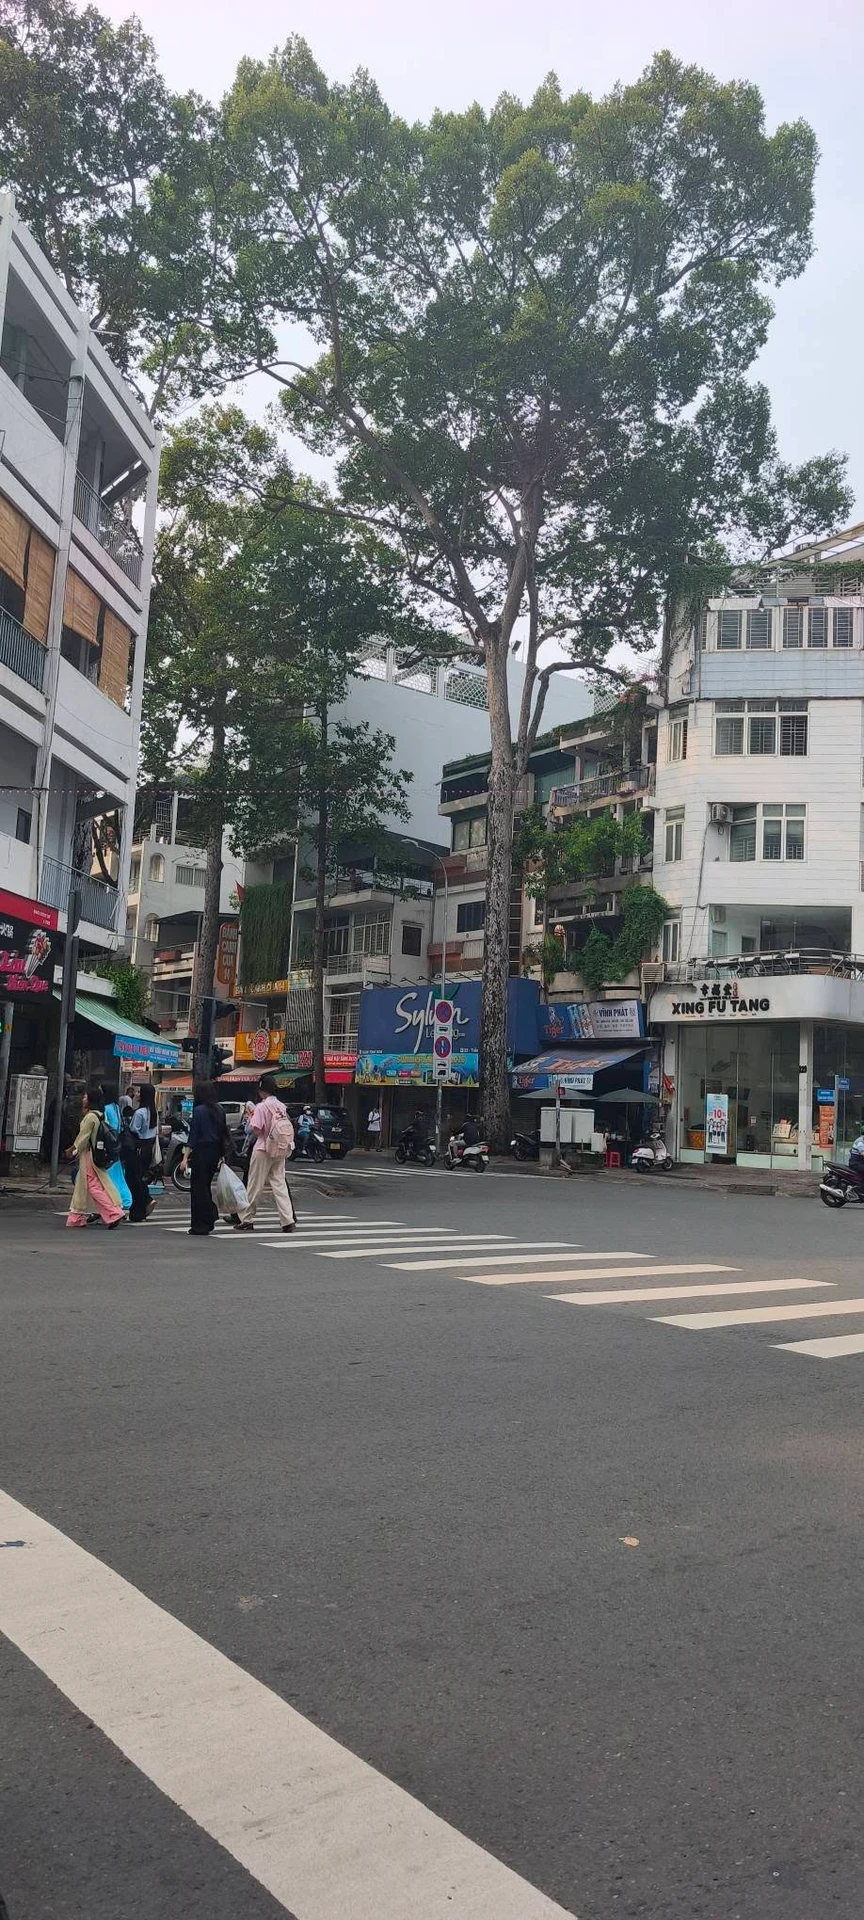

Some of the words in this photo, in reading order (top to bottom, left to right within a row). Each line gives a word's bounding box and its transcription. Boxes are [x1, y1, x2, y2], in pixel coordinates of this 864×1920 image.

[395, 991, 470, 1054] Sylvn
[672, 1002, 704, 1014] XING
[708, 1000, 726, 1013] FU
[730, 998, 770, 1012] TANG
